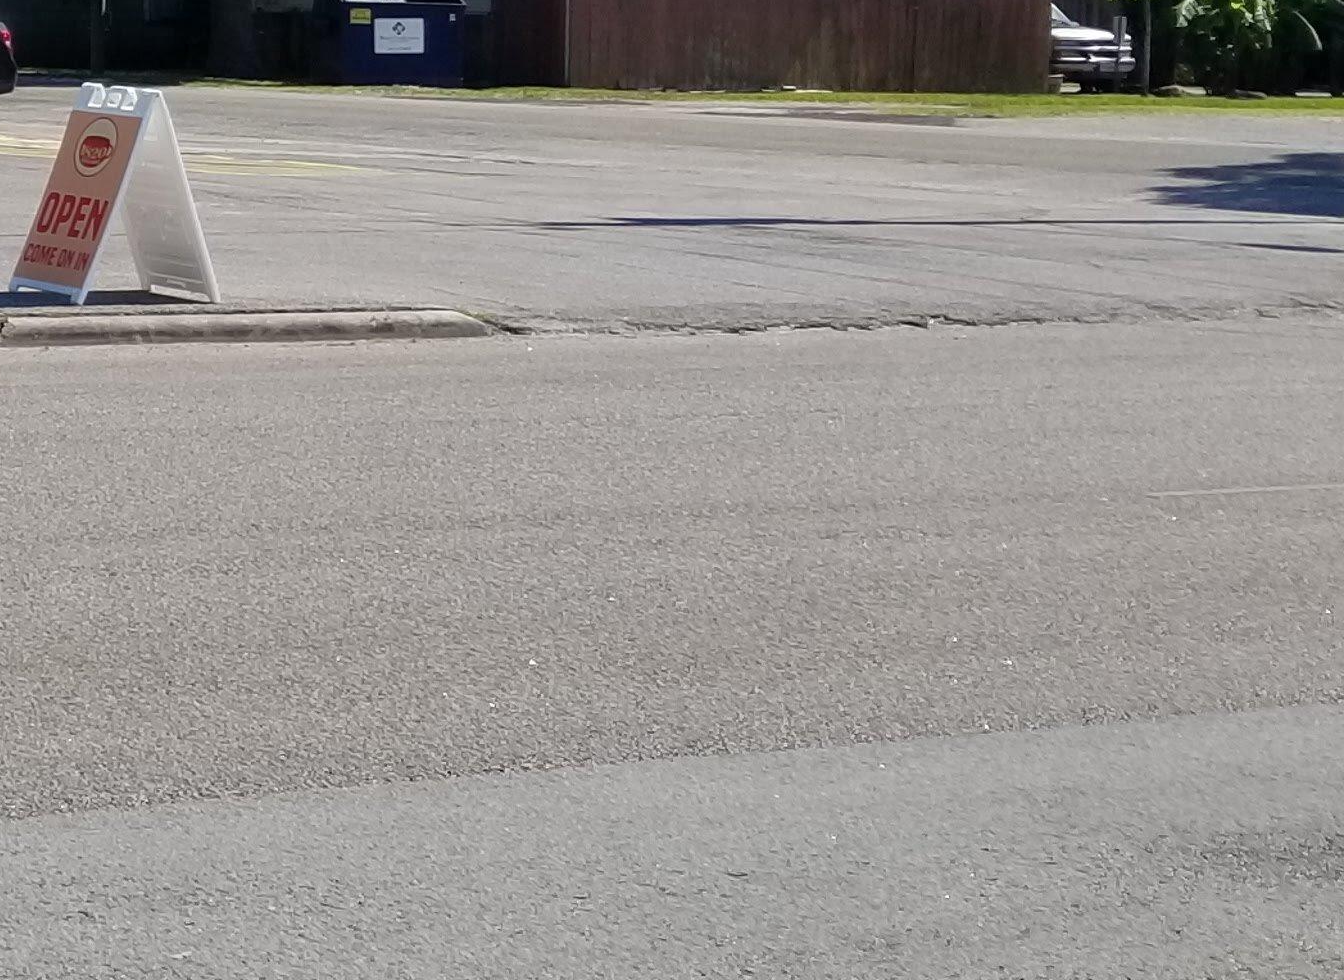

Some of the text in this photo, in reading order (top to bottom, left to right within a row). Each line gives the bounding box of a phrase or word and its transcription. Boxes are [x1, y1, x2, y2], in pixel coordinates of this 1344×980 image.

[36, 192, 109, 241] OPEN
[24, 243, 90, 271] COME ON IN
